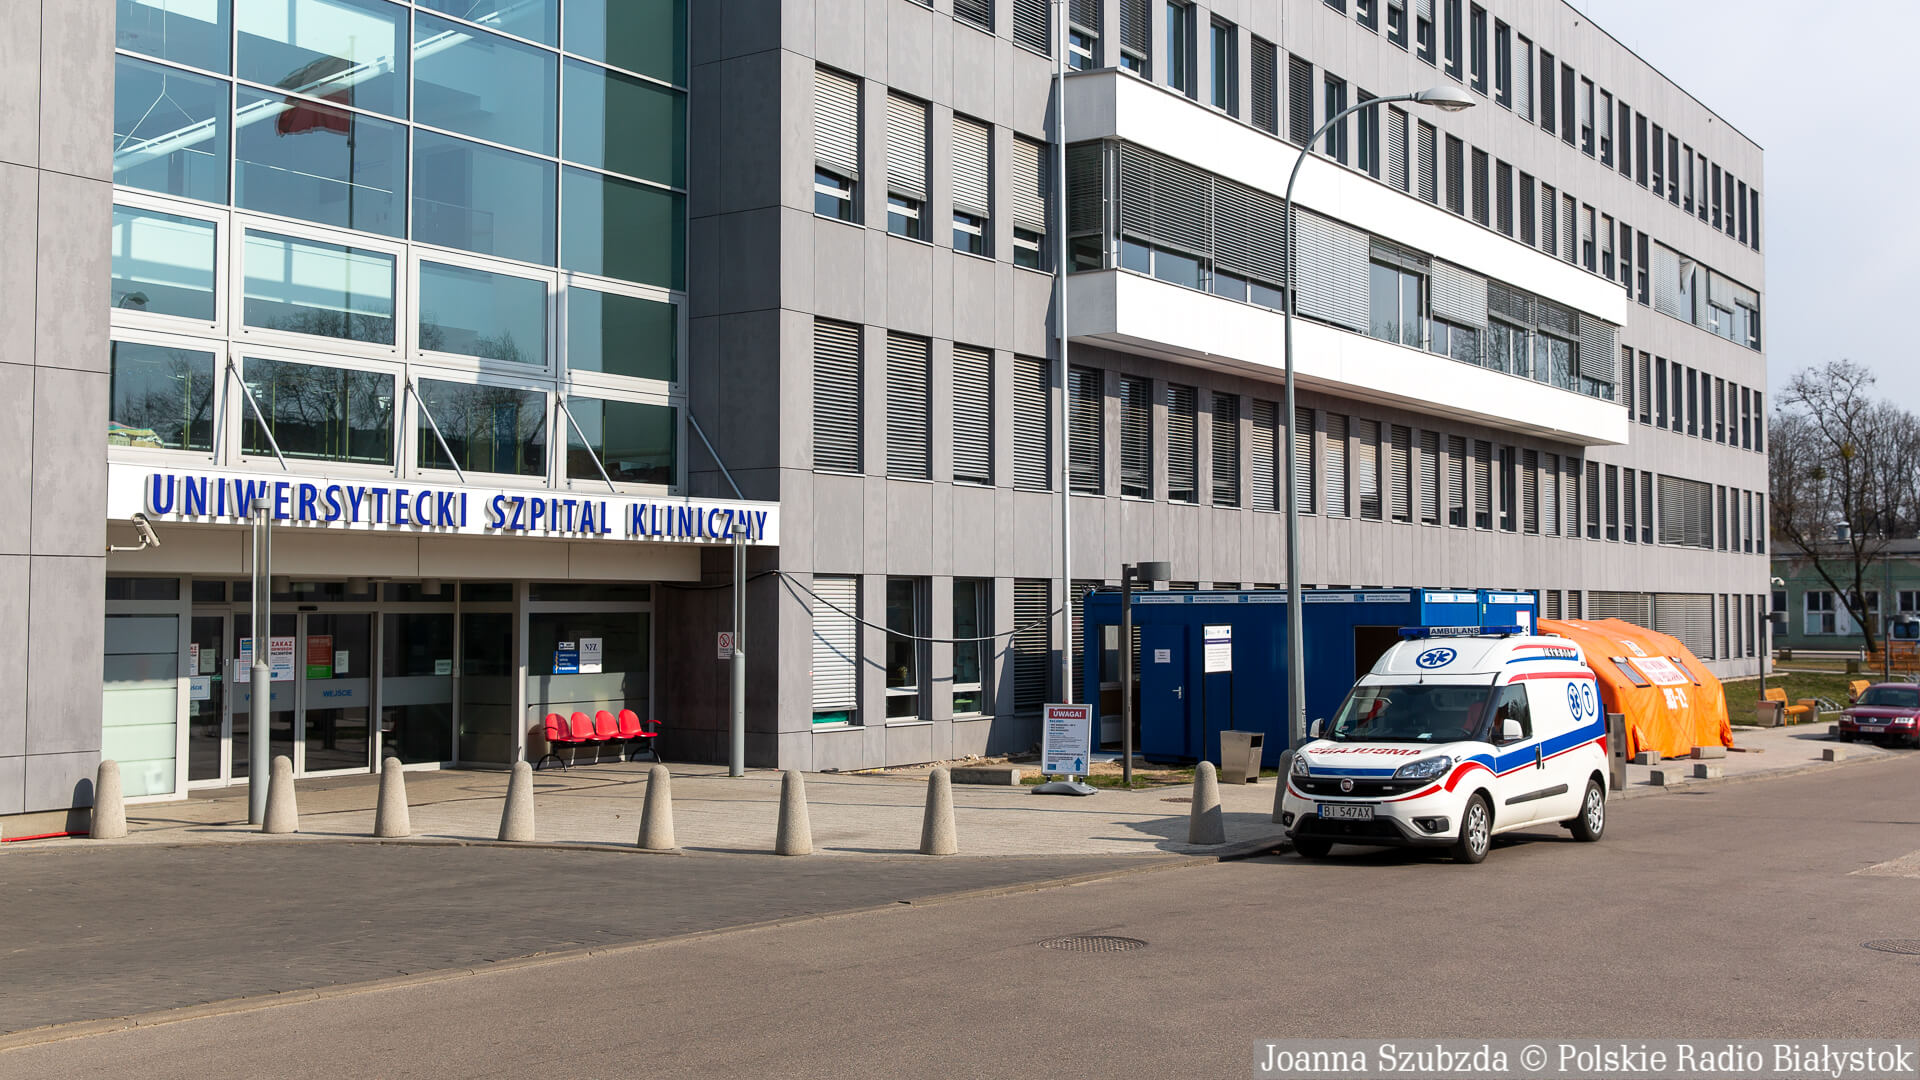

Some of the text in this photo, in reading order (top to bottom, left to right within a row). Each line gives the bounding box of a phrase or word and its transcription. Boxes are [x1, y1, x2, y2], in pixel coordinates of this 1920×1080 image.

[151, 473, 768, 540] UNIWERSYTECKI SZPITAL KLINICZNY
[1430, 627, 1480, 635] AMBULANS
[1324, 806, 1371, 818] BI 547AX
